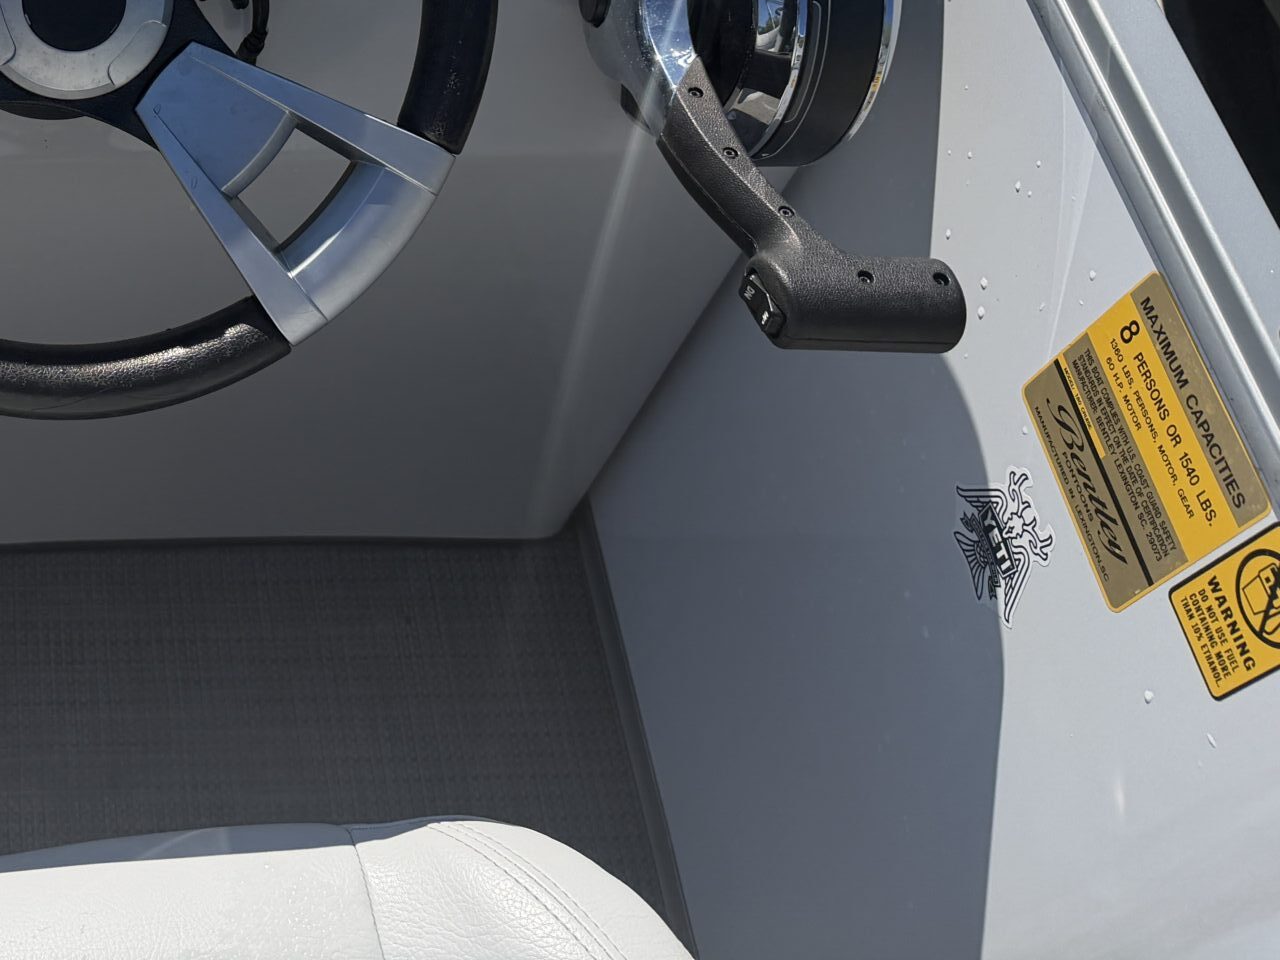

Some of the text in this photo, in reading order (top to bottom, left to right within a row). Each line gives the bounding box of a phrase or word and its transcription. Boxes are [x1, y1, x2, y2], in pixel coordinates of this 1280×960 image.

[1106, 356, 1142, 432] 60 H.P. MOTOR
[1120, 319, 1219, 528] 8 PERSONS OR 1540 LBS.
[1140, 295, 1246, 511] MAXIMUM CAPACITIES
[1034, 406, 1070, 486] MANUFACTURED
[1067, 487, 1076, 500] IN
[1046, 400, 1129, 565] Bentley
[1062, 451, 1095, 523] PONTOONS
[1071, 359, 1099, 416] MANUFACTURER:
[1096, 416, 1116, 456] BENTLEY
[1114, 458, 1140, 511] LEXINGTON
[1145, 531, 1162, 563] 29073
[1078, 353, 1170, 558] STANDARDS IN EFFECT ON THE DATE OF CERTIFICATION
[1084, 348, 1176, 552] THIS BOAT COMPLIES WITH U.S. COAST GUARD SAFETY
[1133, 390, 1160, 444] PERSONS,
[1157, 444, 1180, 486] MOTOR,
[1176, 488, 1195, 520] GEAR
[983, 509, 1012, 574] YETI
[1179, 597, 1195, 621] THAN
[1191, 623, 1204, 642] 10%
[1188, 593, 1231, 680] CONTAINING MORE
[1197, 589, 1240, 673] DO NOT USE FUEL
[1206, 575, 1257, 672] WARNING
